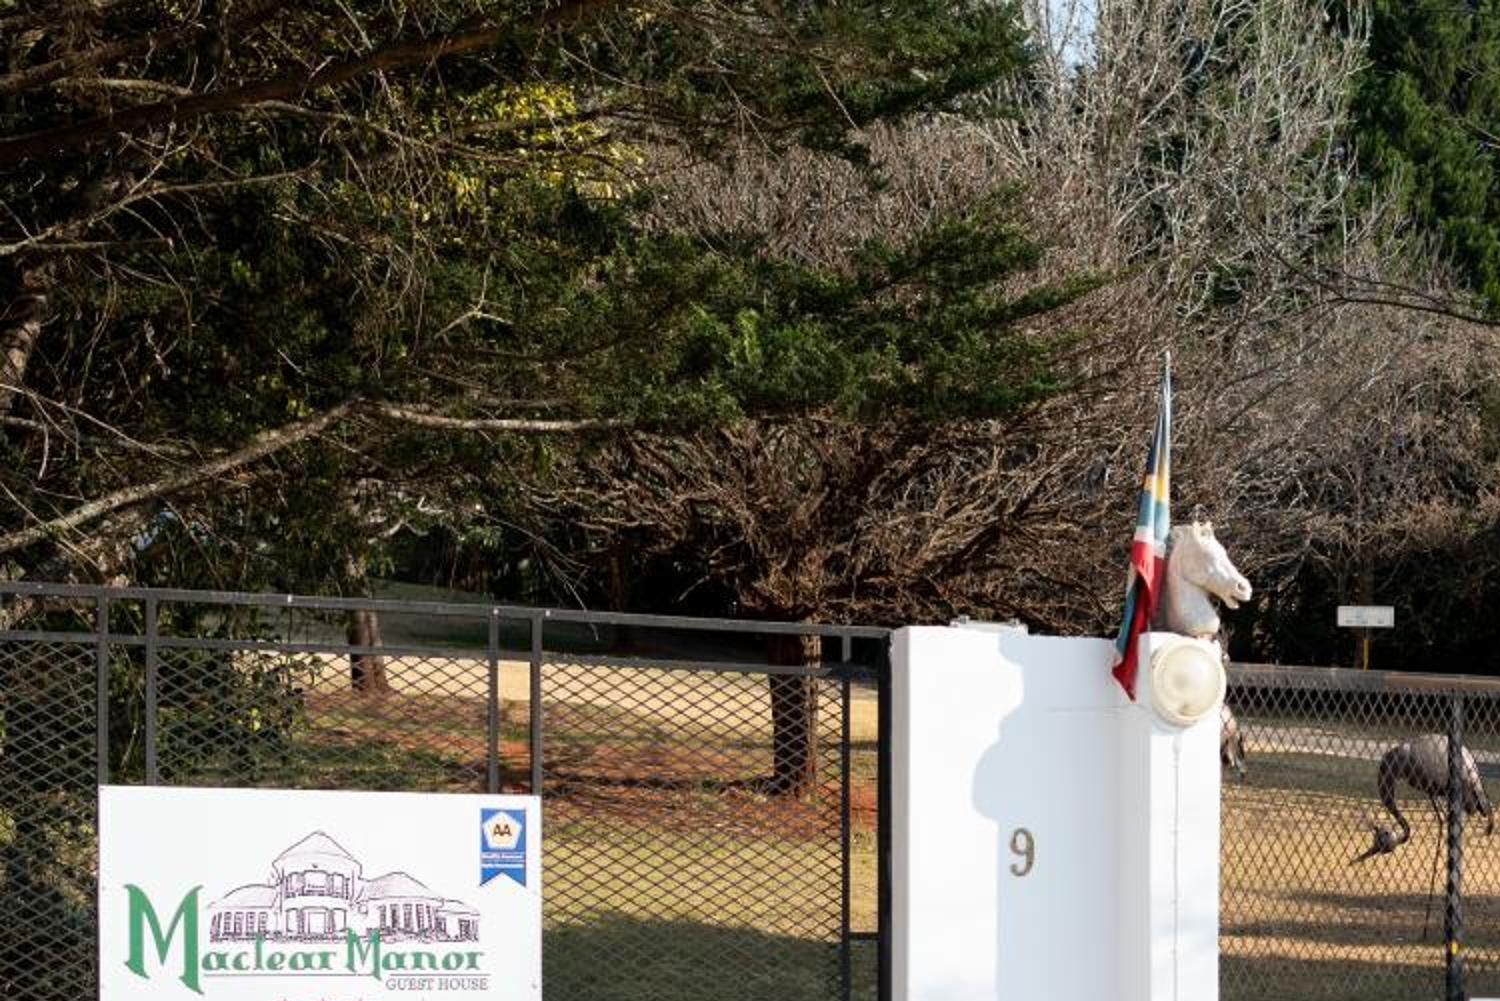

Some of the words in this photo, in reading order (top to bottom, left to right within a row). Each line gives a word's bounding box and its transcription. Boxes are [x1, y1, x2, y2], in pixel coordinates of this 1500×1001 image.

[493, 823, 512, 837] AA
[1009, 827, 1035, 877] 9
[123, 883, 337, 995] Maclear
[345, 925, 485, 981] Manor
[385, 977, 434, 991] GUEST
[437, 976, 489, 990] HOUSE
